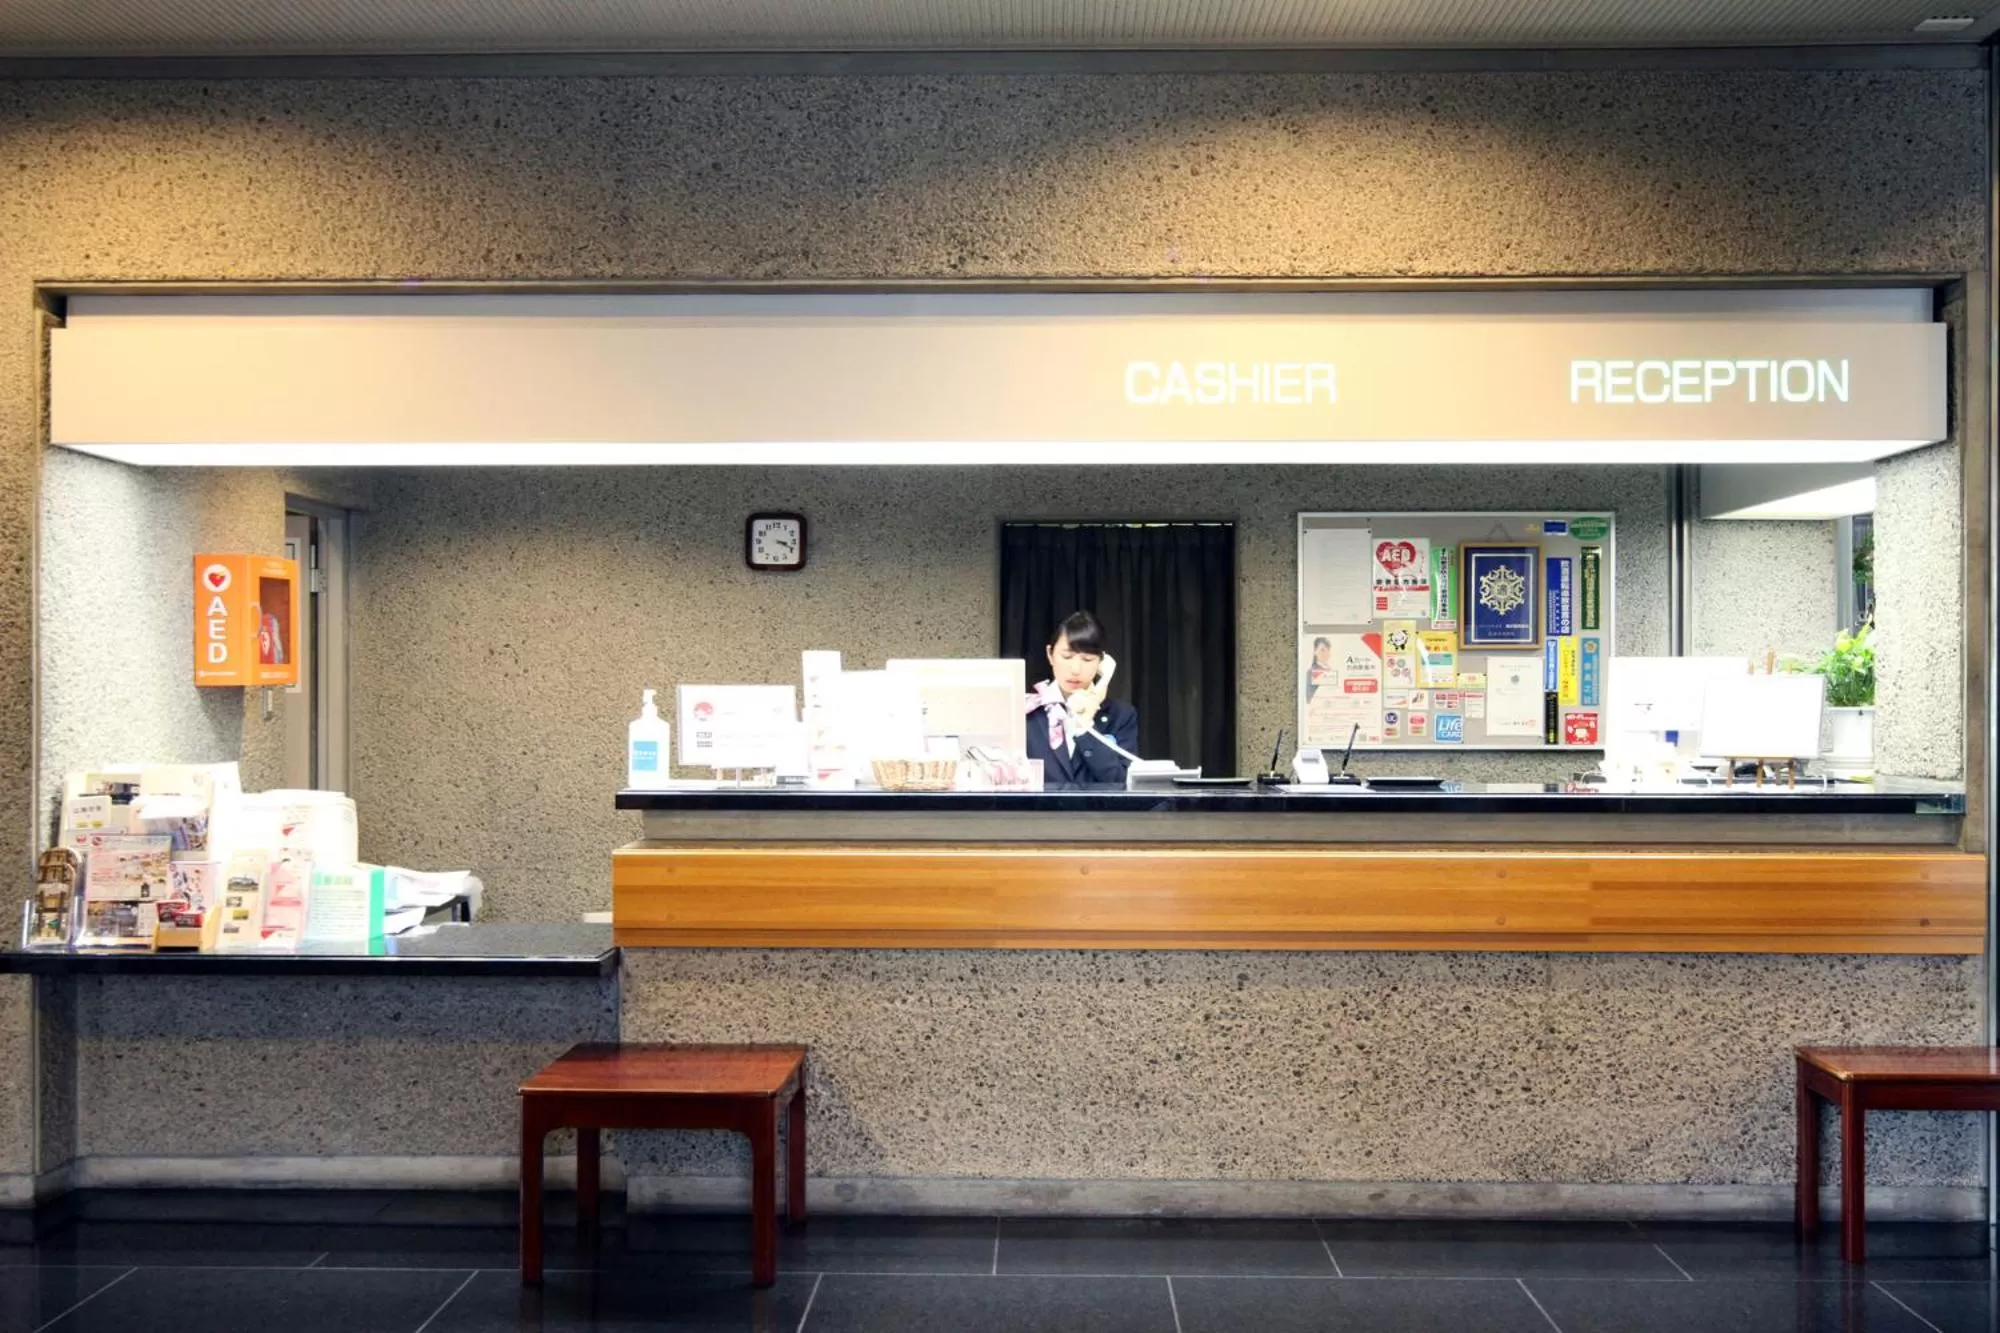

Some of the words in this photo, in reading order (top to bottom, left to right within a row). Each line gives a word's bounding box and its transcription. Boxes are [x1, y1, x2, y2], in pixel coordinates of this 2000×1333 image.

[1124, 360, 1337, 405] CASHIER
[1570, 360, 1849, 404] RECEPTION
[1380, 548, 1411, 562] AED
[207, 595, 228, 664] AED
